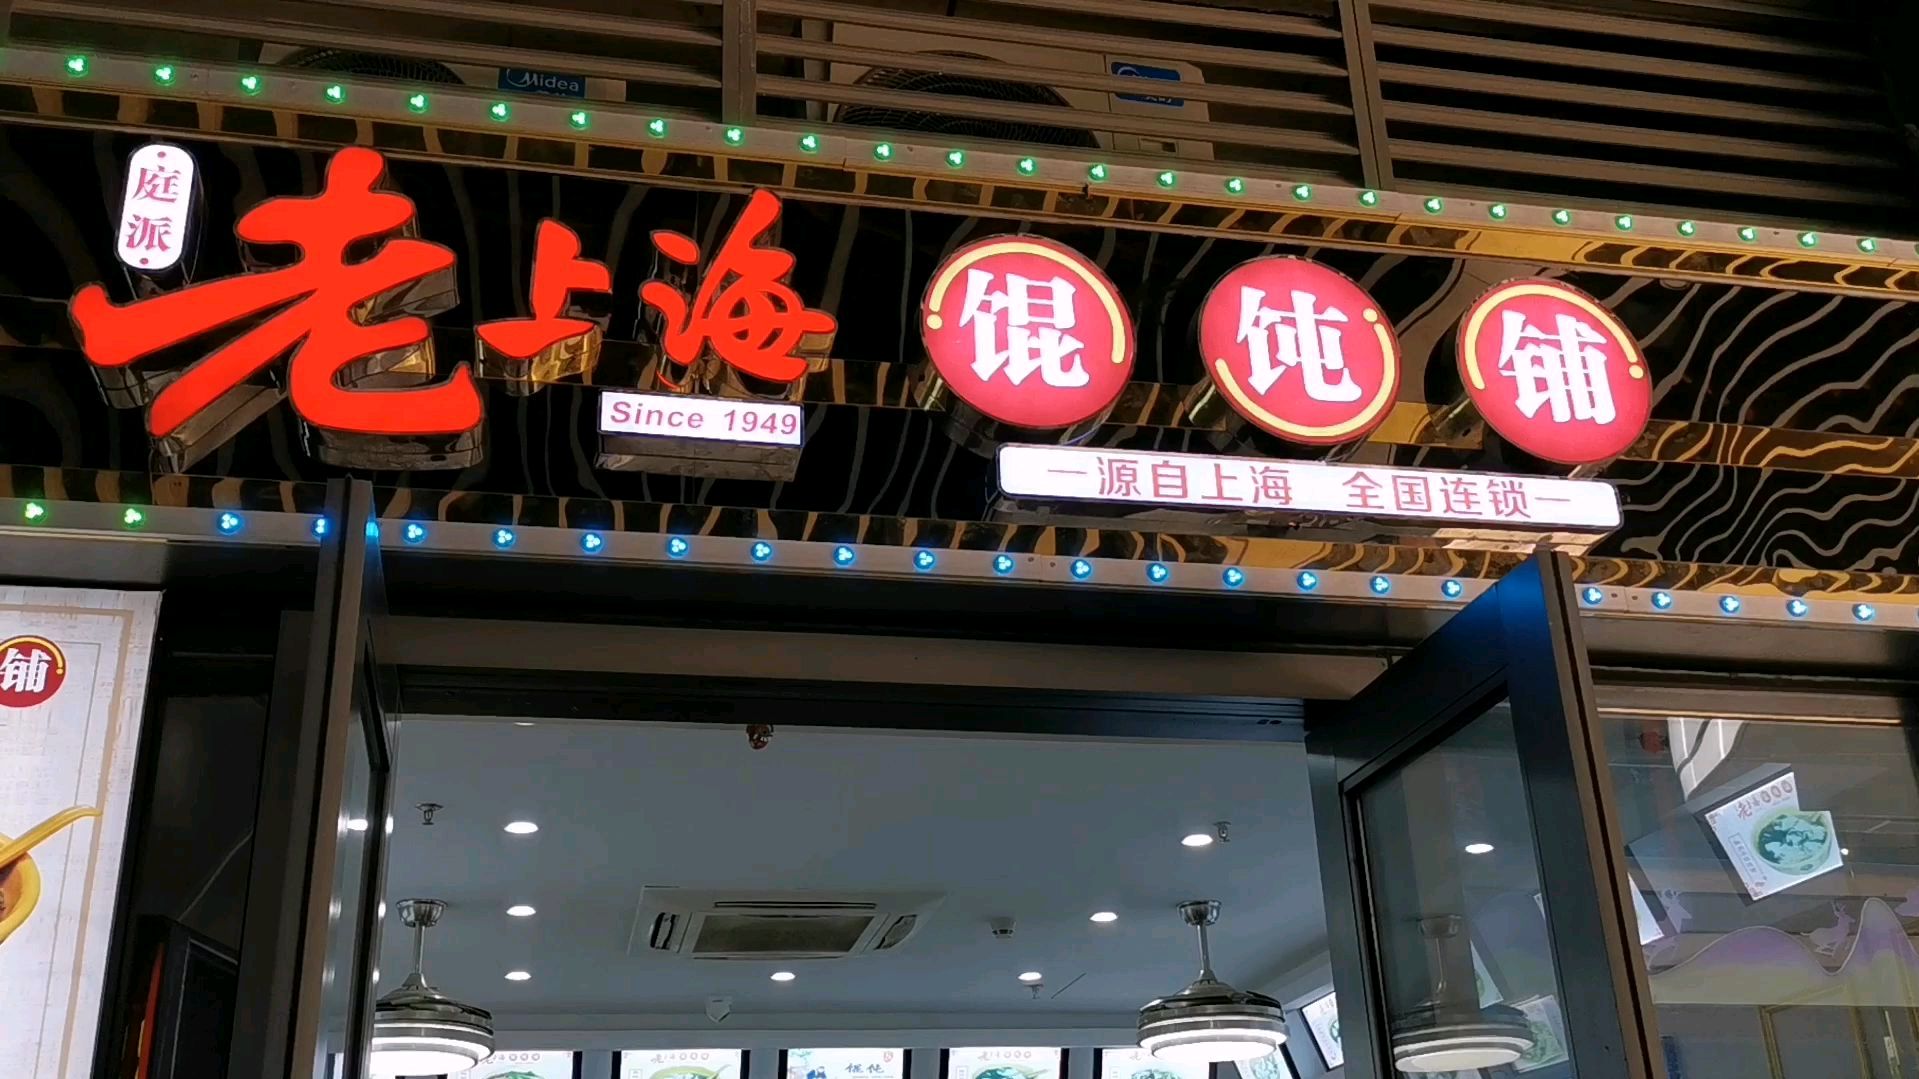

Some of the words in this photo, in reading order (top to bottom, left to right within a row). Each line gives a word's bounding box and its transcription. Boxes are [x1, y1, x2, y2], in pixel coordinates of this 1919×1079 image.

[506, 68, 580, 92] Midea
[126, 165, 182, 253] 庭派
[70, 145, 837, 434] 老上海
[959, 267, 1617, 425] 馄饨铺
[610, 401, 704, 429] Since
[724, 409, 797, 435] 1949
